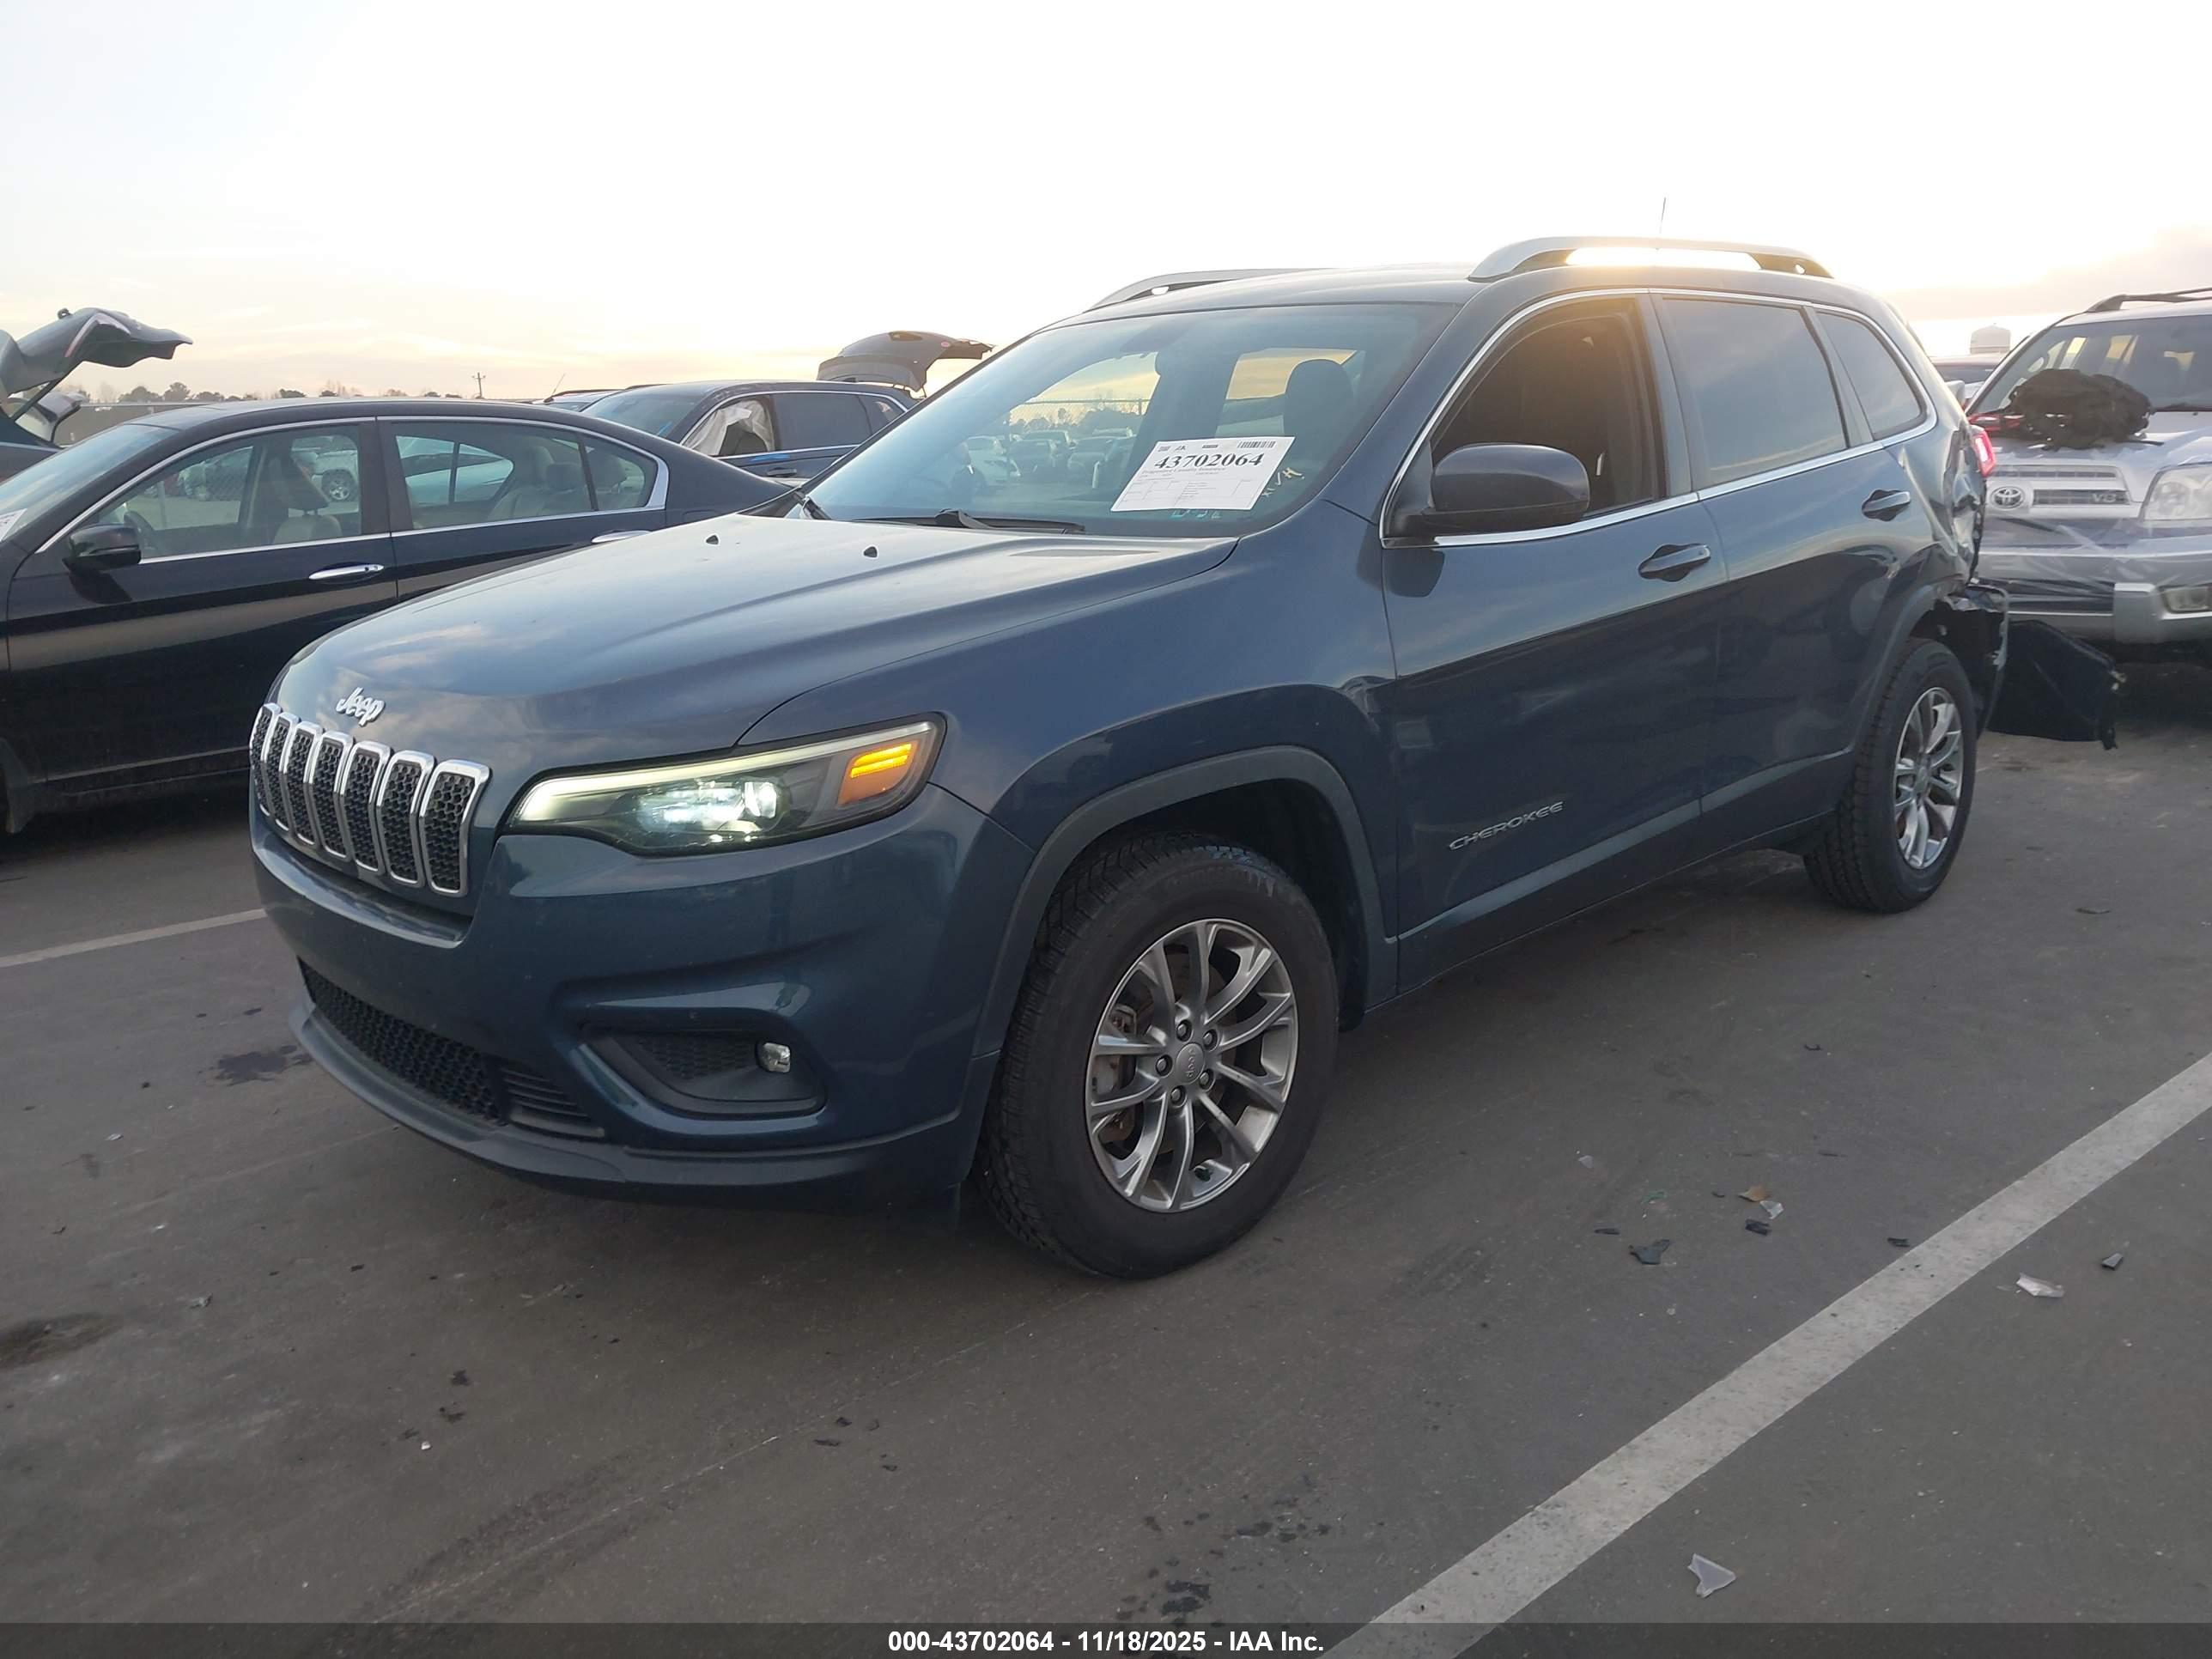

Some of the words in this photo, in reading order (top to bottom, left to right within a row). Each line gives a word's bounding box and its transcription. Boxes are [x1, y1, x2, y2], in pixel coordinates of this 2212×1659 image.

[1154, 453, 1265, 469] 43702064
[336, 687, 385, 726] Jeep
[1449, 800, 1564, 851] CHEROKEE
